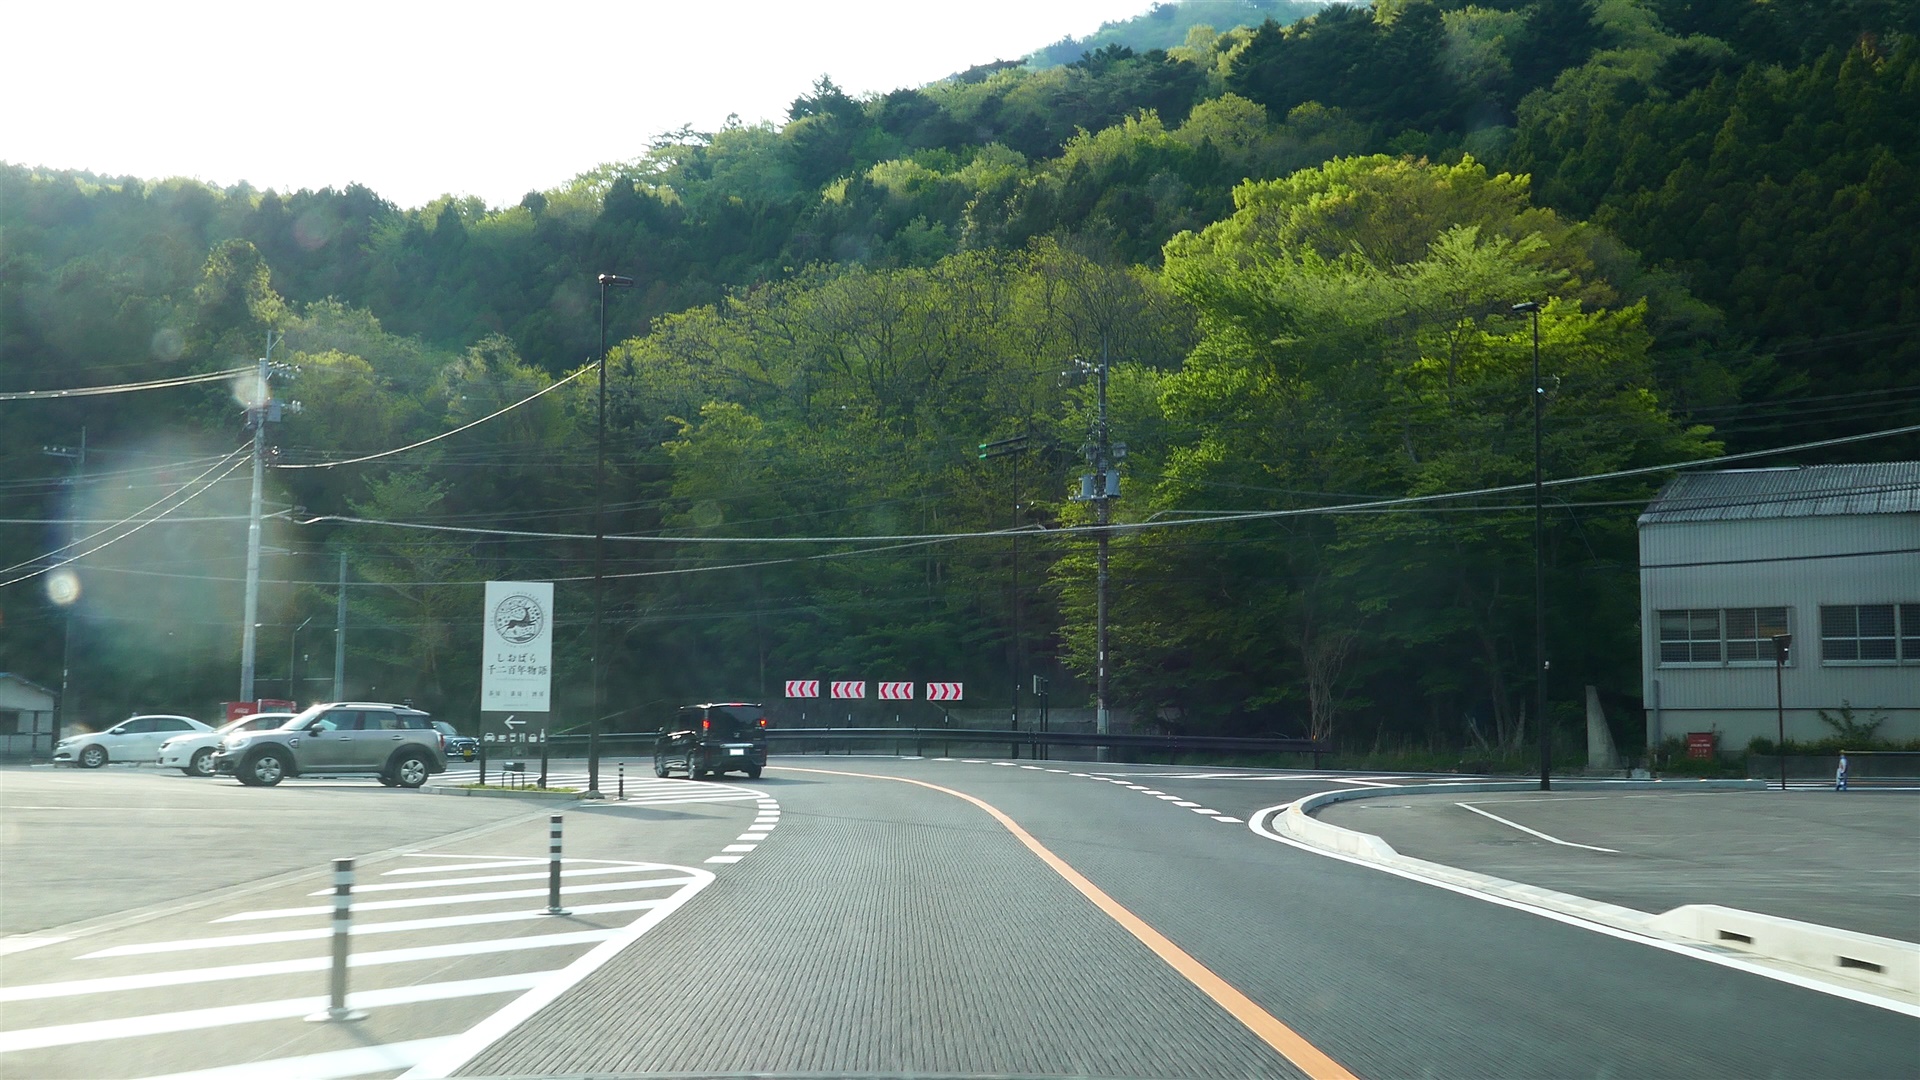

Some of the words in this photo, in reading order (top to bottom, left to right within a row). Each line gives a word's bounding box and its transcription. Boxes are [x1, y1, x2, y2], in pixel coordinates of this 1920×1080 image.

[497, 653, 536, 663] しおばら
[487, 664, 548, 676] 千二百年物語
